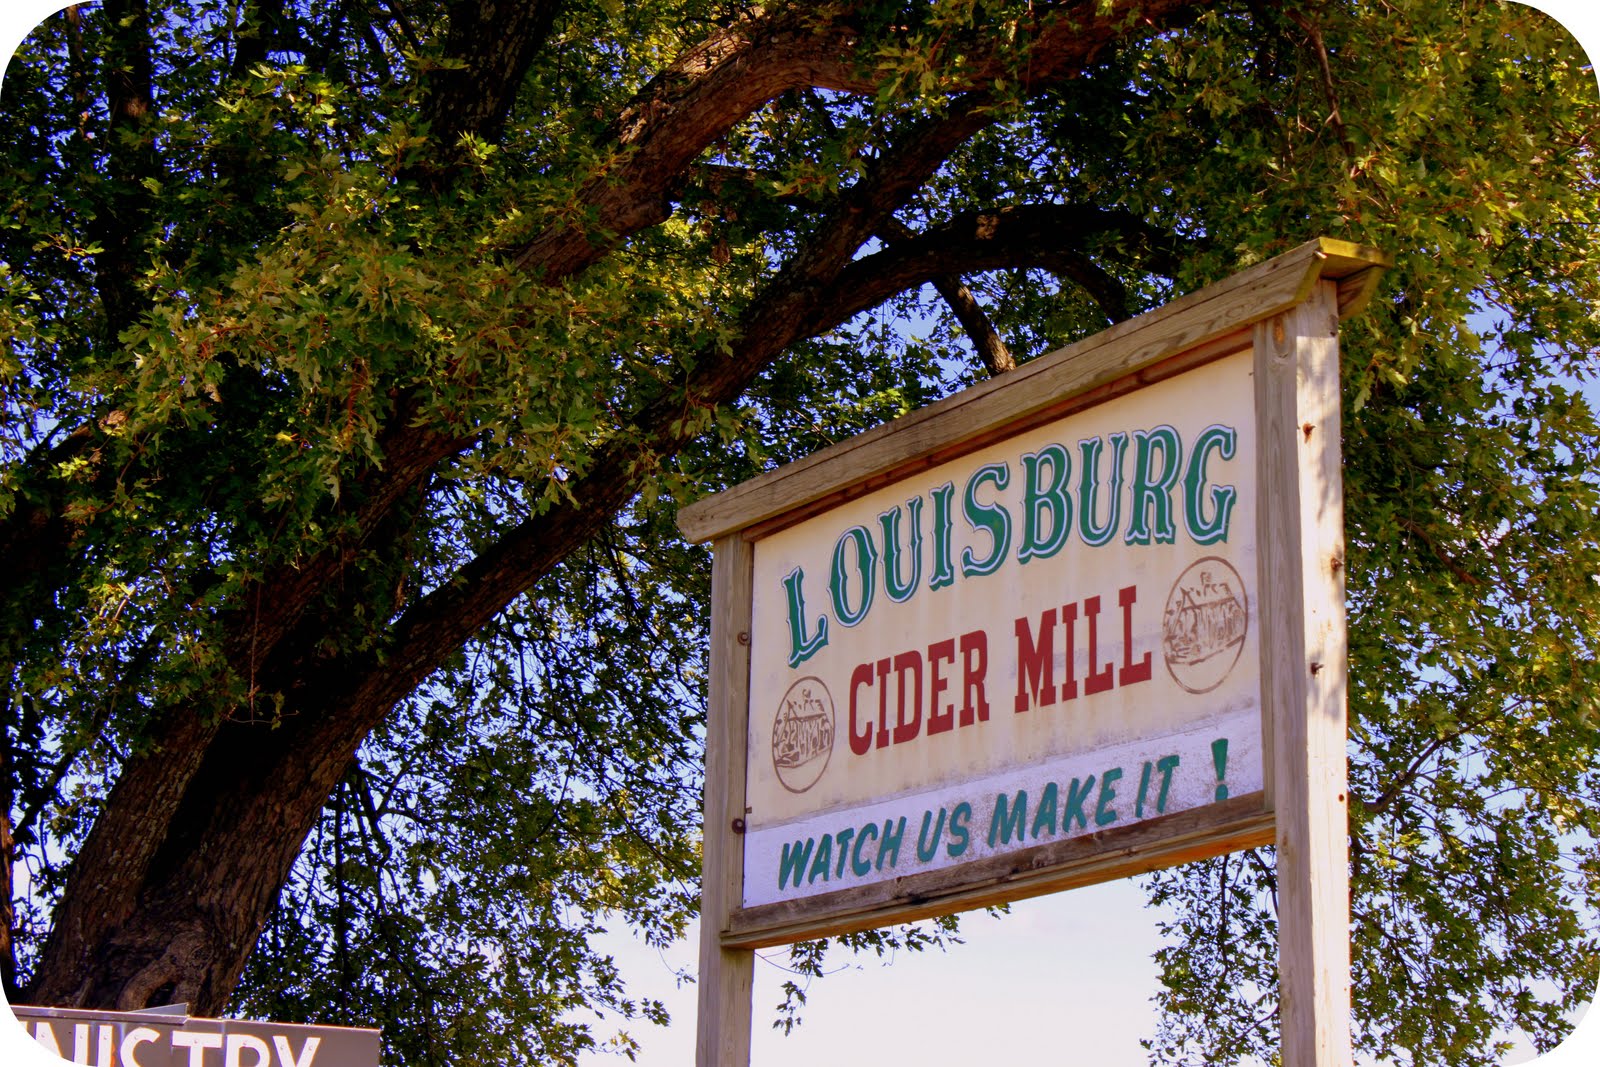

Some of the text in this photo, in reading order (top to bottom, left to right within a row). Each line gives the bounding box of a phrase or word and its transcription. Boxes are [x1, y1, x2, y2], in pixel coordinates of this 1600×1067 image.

[781, 424, 1236, 668] LOUISBURG
[849, 585, 1152, 755] CIDER MILL
[778, 816, 907, 890] WATCH
[917, 802, 970, 862] US
[987, 767, 1123, 847] MAKE
[1136, 754, 1180, 818] IT
